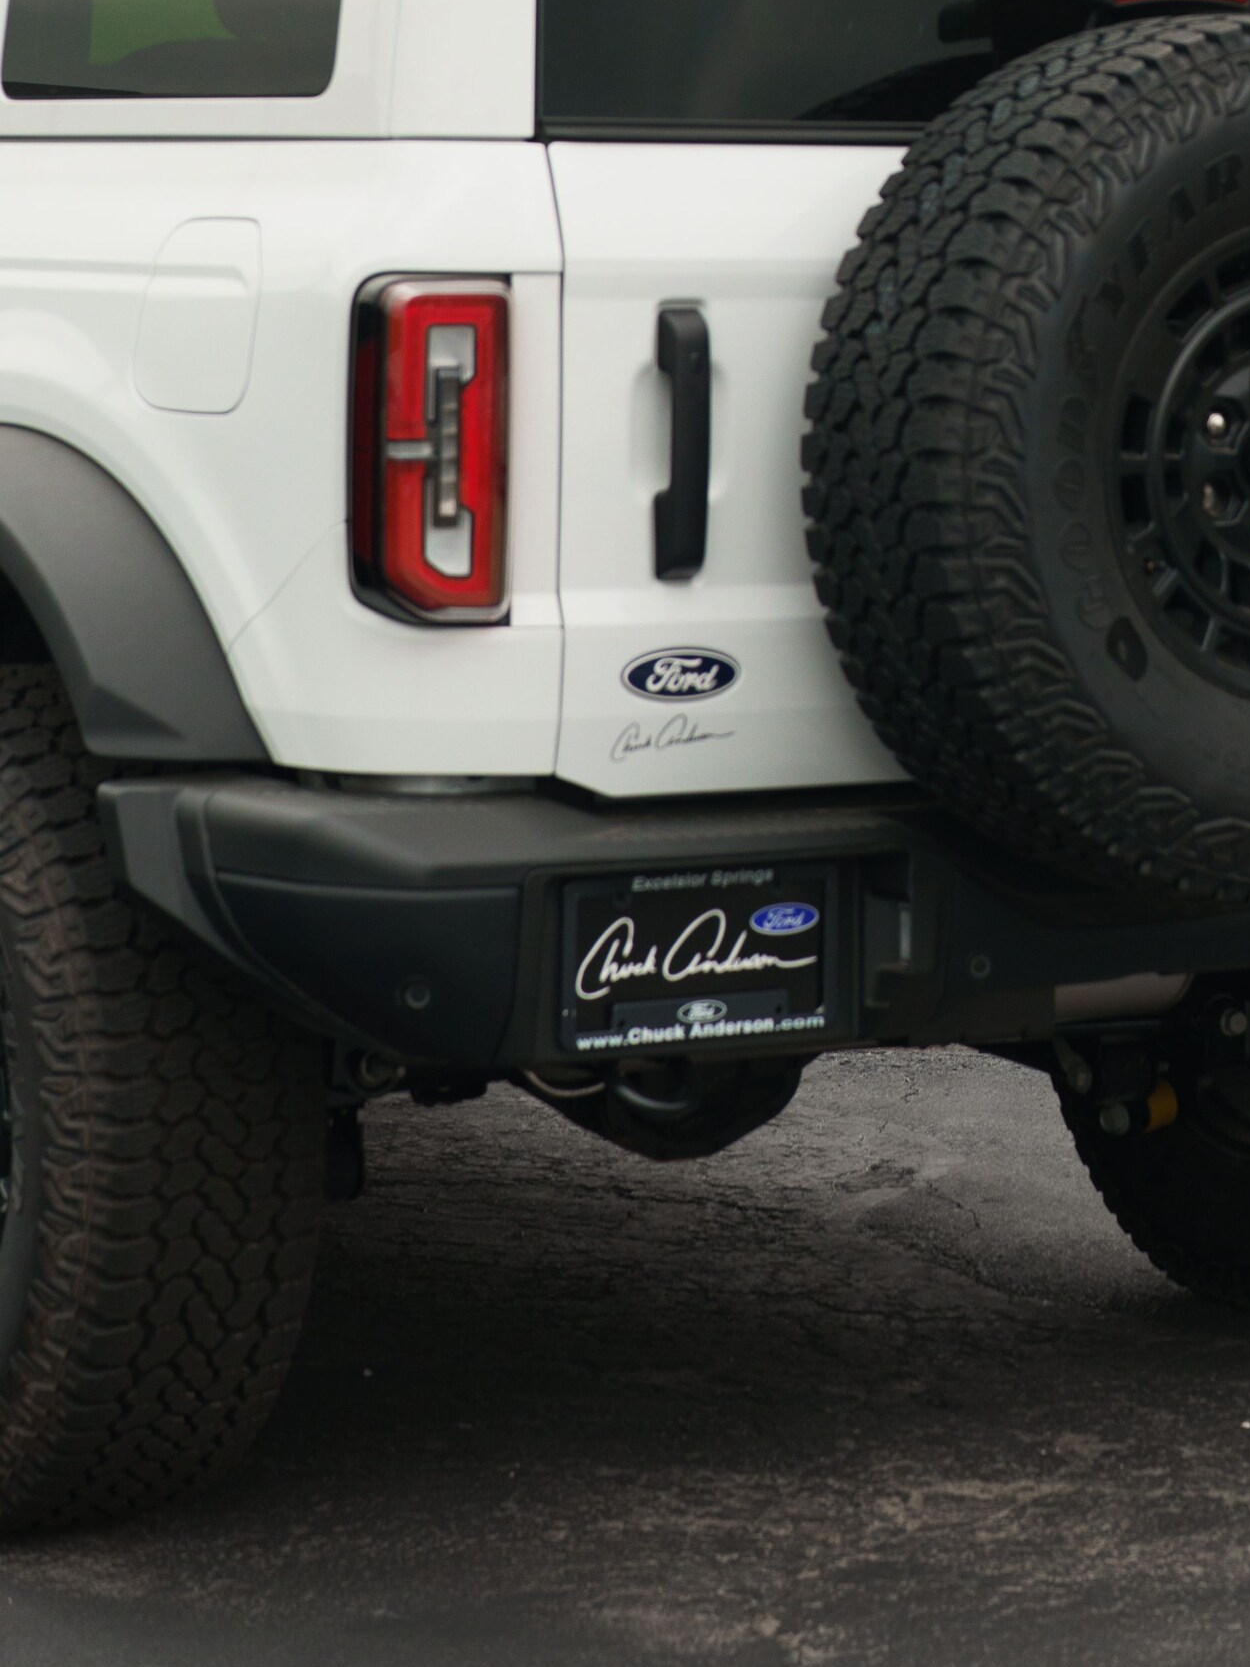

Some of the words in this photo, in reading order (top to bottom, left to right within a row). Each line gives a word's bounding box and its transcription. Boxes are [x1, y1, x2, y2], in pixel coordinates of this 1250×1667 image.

[645, 656, 720, 693] Ford
[631, 870, 706, 893] Excelsior
[710, 867, 774, 889] Springs
[762, 907, 804, 930] Ford
[576, 916, 658, 1000] Chuck
